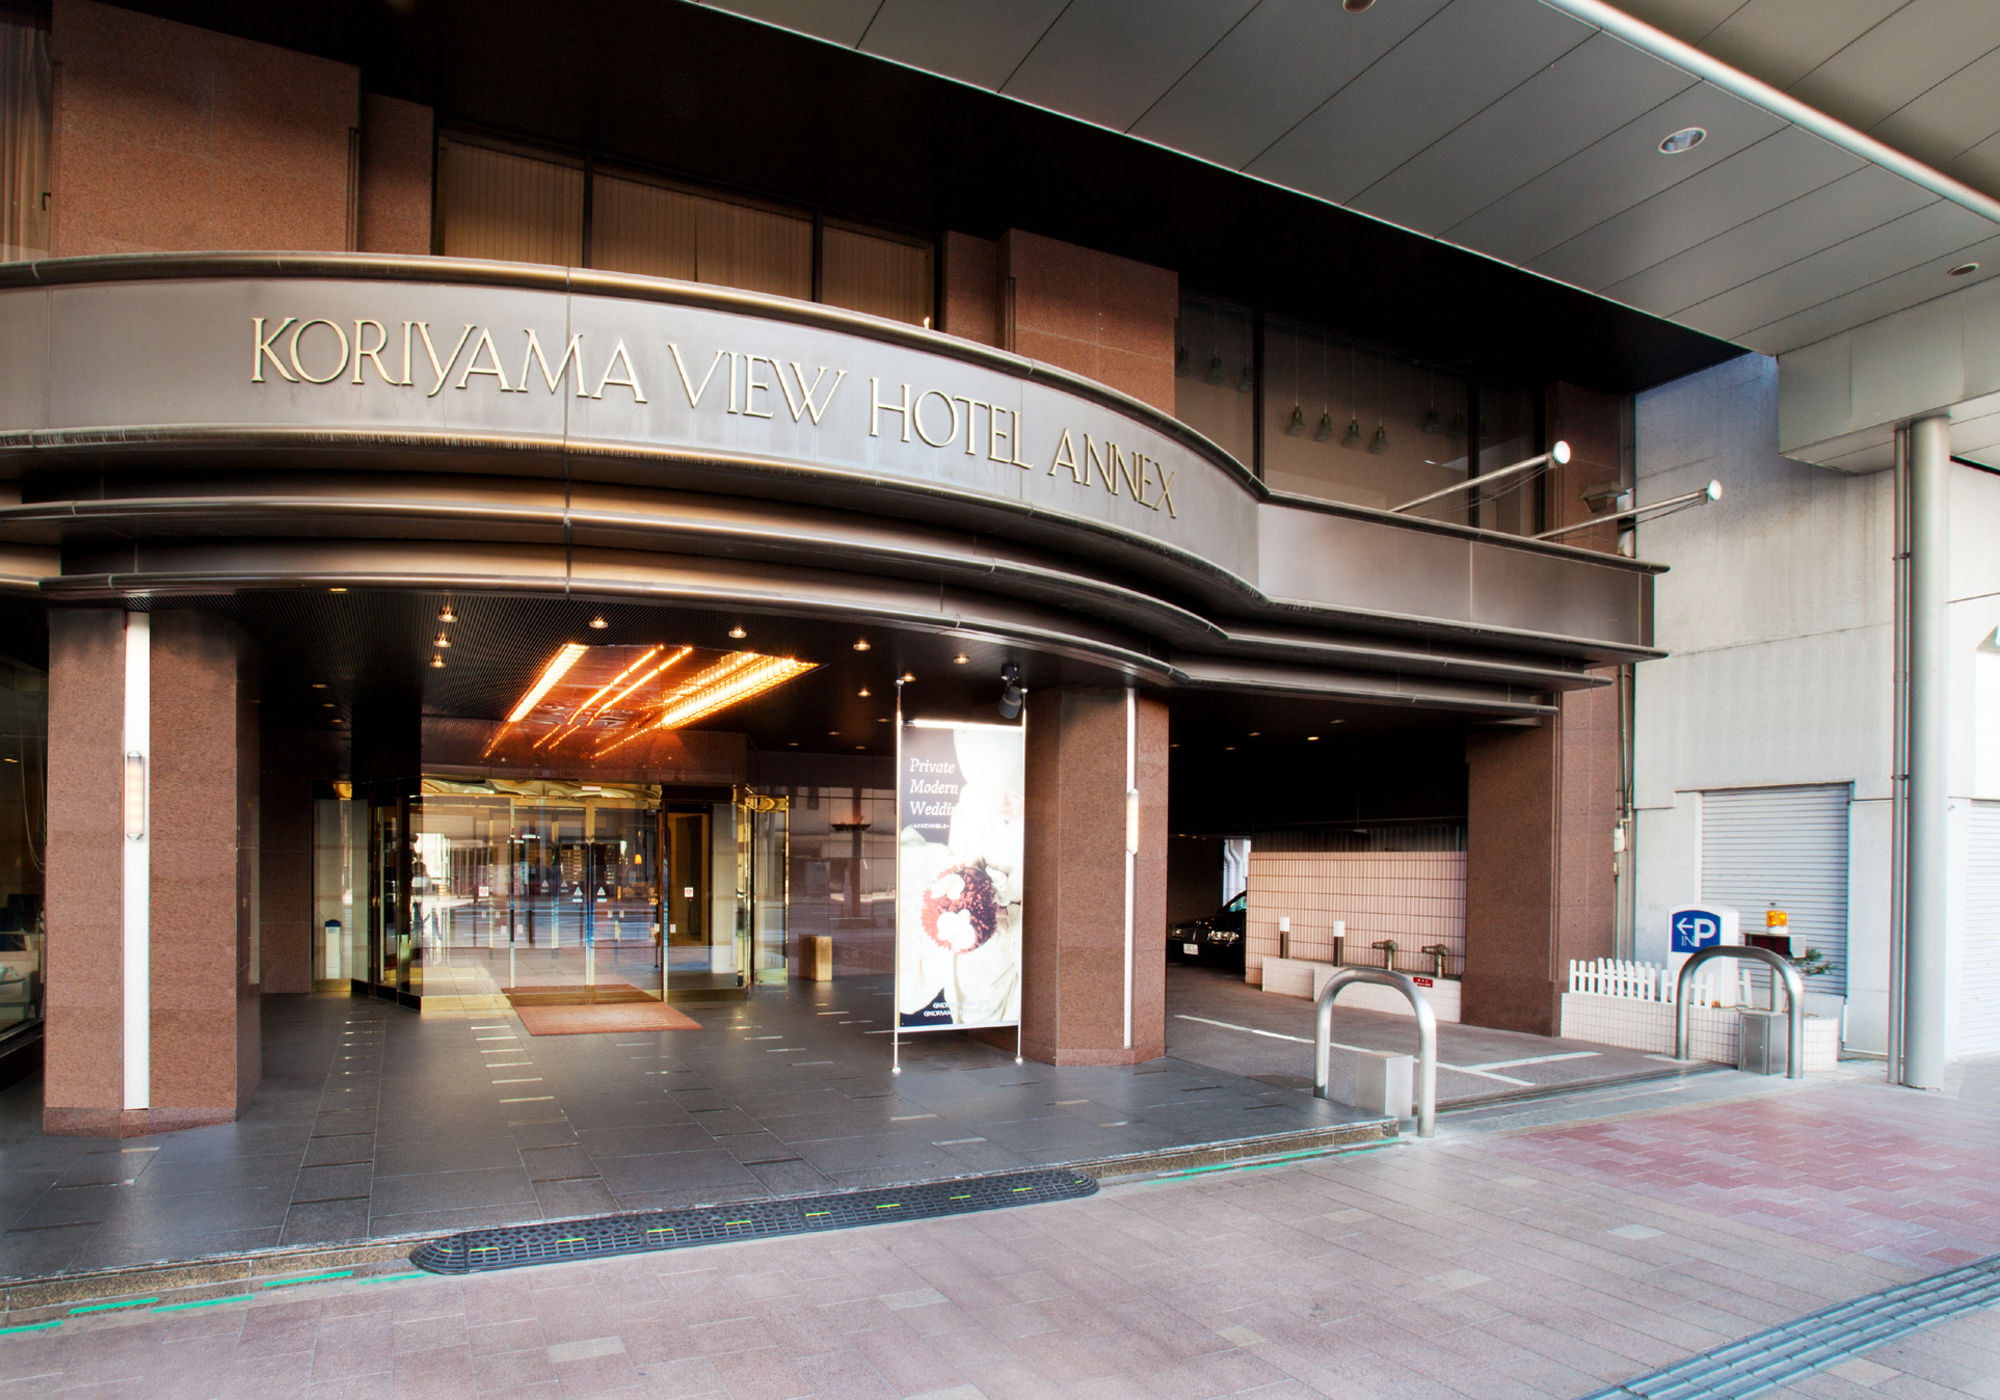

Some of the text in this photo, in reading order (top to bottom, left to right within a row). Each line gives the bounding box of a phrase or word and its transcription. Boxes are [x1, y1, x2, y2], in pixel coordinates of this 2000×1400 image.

[250, 316, 1177, 519] KORIYAMA VIEW HOTEL ANNEX
[909, 758, 955, 774] Private
[909, 779, 959, 795] Modern
[909, 800, 954, 816] Weddi
[1694, 918, 1717, 948] P
